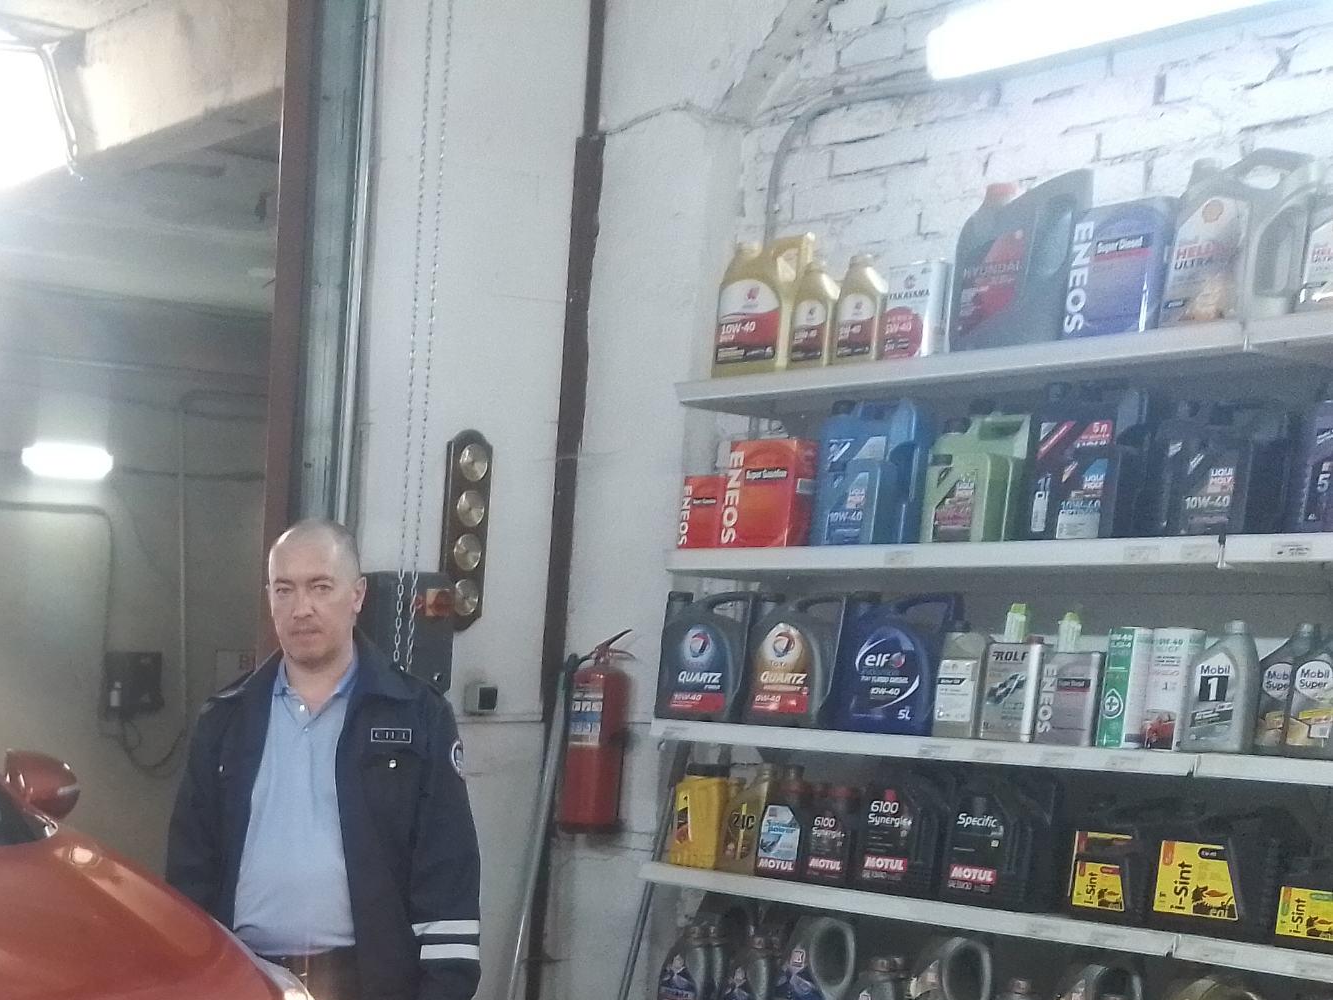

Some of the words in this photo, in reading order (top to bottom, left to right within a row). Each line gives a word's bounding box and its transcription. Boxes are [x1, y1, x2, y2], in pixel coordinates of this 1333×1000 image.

[1064, 221, 1095, 334] ENEOS
[720, 450, 745, 544] ENEOS
[677, 485, 694, 545] ENEOS
[865, 653, 890, 668] elf
[991, 650, 1029, 662] ROLF
[1200, 665, 1231, 675] Mobil
[1267, 670, 1289, 680] Mob
[1300, 669, 1330, 679] Mobil
[678, 671, 723, 684] QUARTZ
[760, 671, 808, 685] QUARTZ
[1299, 679, 1328, 689] Super
[1208, 677, 1219, 701] 1
[1266, 681, 1289, 691] Supe
[1036, 664, 1058, 734] ENEOS
[871, 801, 900, 814] 6100
[814, 816, 836, 828] 6100
[957, 813, 998, 828] Specific
[758, 858, 794, 870] MOTUL
[809, 858, 842, 871] MOTUL
[864, 856, 904, 871] MOTUL
[950, 866, 994, 882] MOTUL
[1170, 860, 1193, 910] i-Sint
